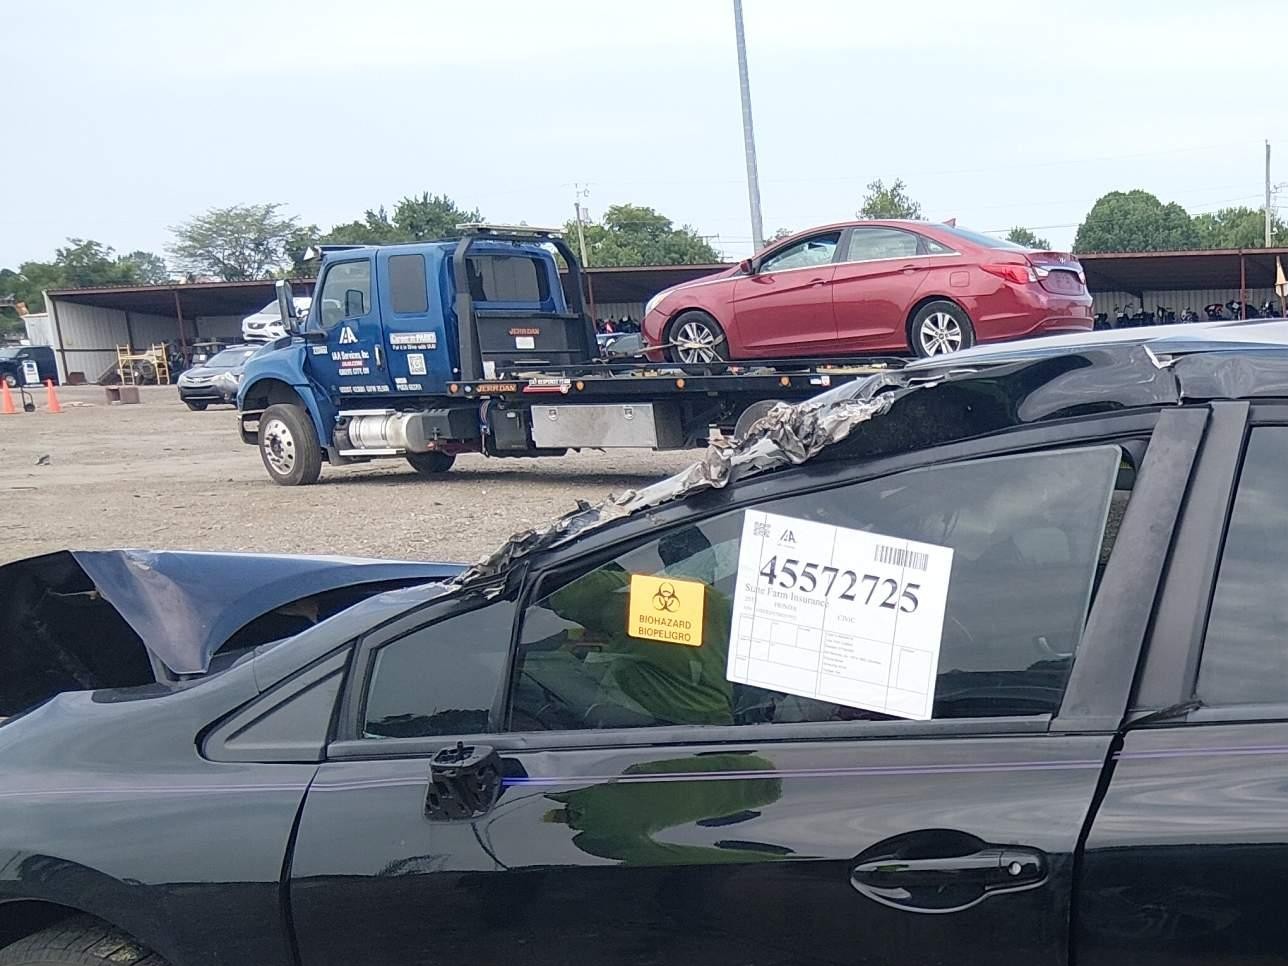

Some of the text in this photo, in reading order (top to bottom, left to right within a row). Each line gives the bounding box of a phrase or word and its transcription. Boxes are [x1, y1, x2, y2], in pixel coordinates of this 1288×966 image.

[759, 555, 921, 613] 45572725
[767, 587, 789, 601] Farm
[790, 591, 830, 608] Insurance
[639, 614, 692, 630] BIOHAZARD
[638, 626, 692, 642] BIOPELIGRO
